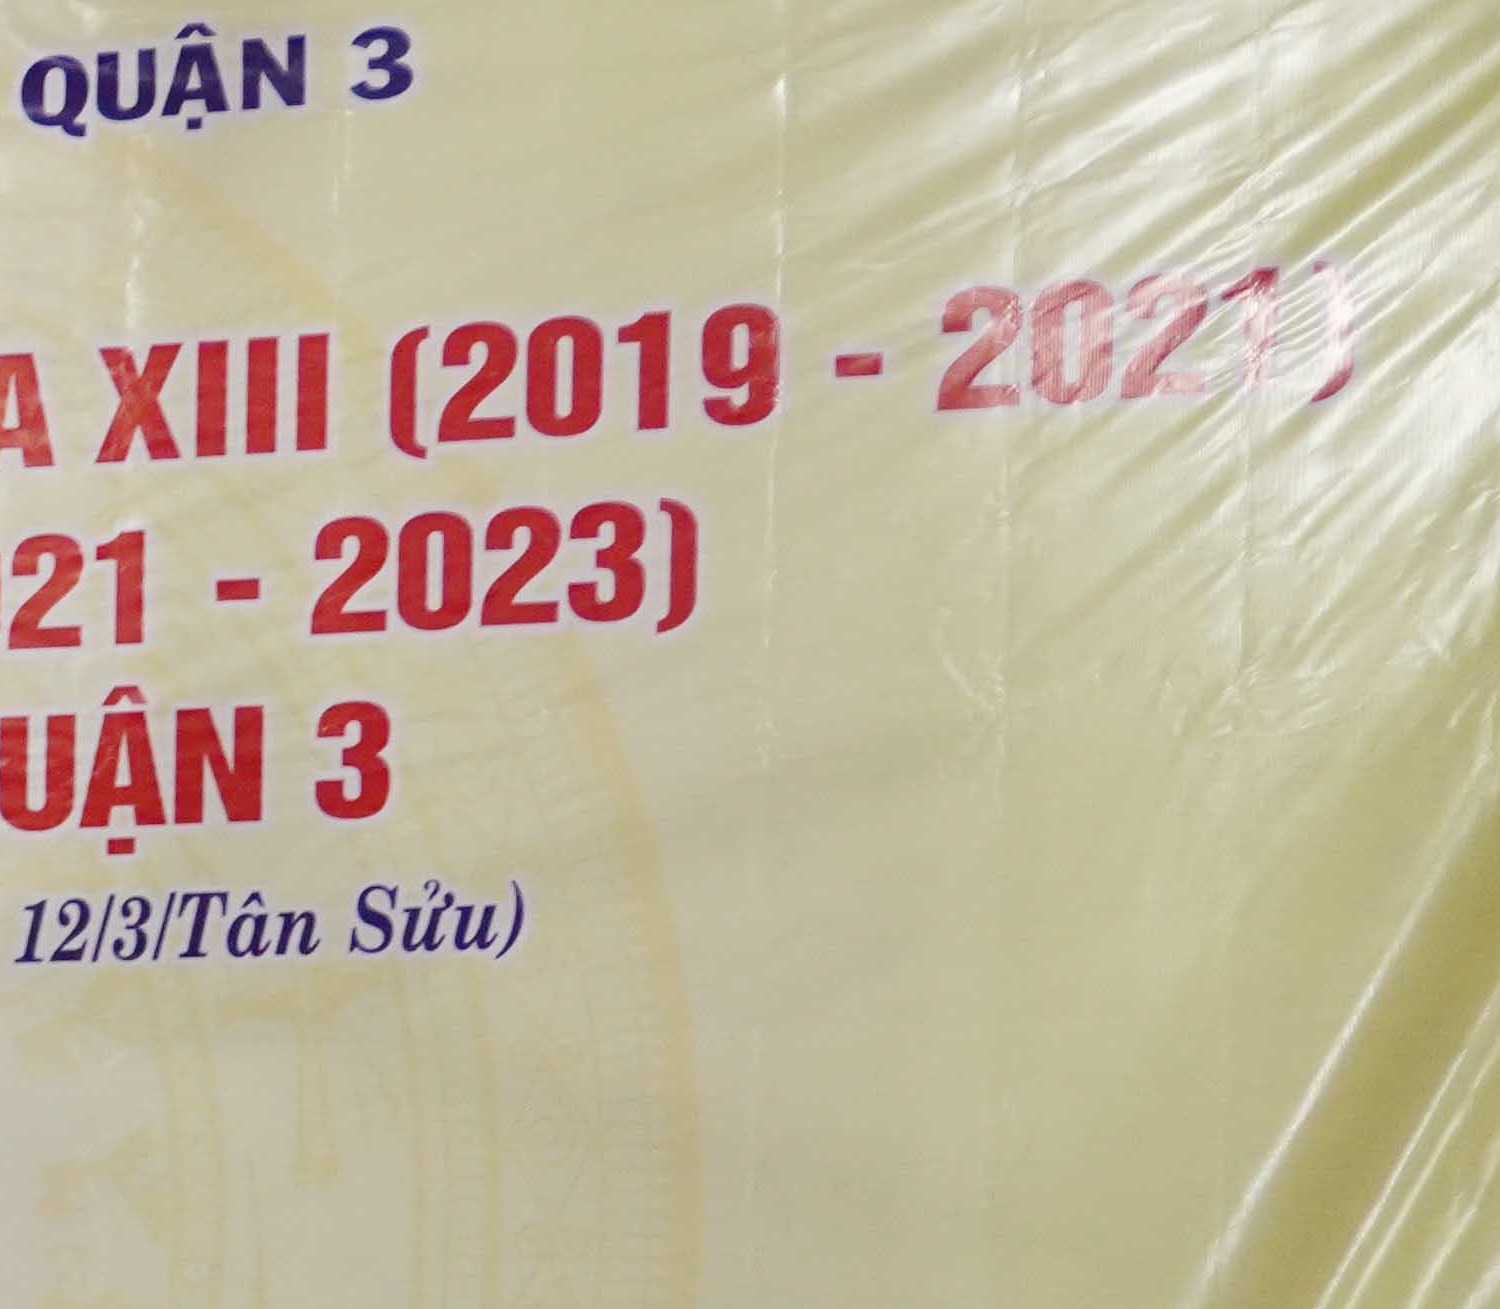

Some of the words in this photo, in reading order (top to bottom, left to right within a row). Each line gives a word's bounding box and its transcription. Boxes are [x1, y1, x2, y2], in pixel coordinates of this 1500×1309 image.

[20, 22, 308, 137] QUẬN
[350, 26, 414, 101] 3
[95, 332, 331, 464] XIII
[390, 303, 780, 458] (2019
[834, 352, 883, 378] -
[934, 260, 1356, 412] 2021)
[216, 578, 260, 602] -
[311, 498, 698, 634] 2023)
[314, 700, 391, 820] 3
[14, 889, 320, 964] 12/3/Tân
[350, 879, 525, 958] Sửu)
